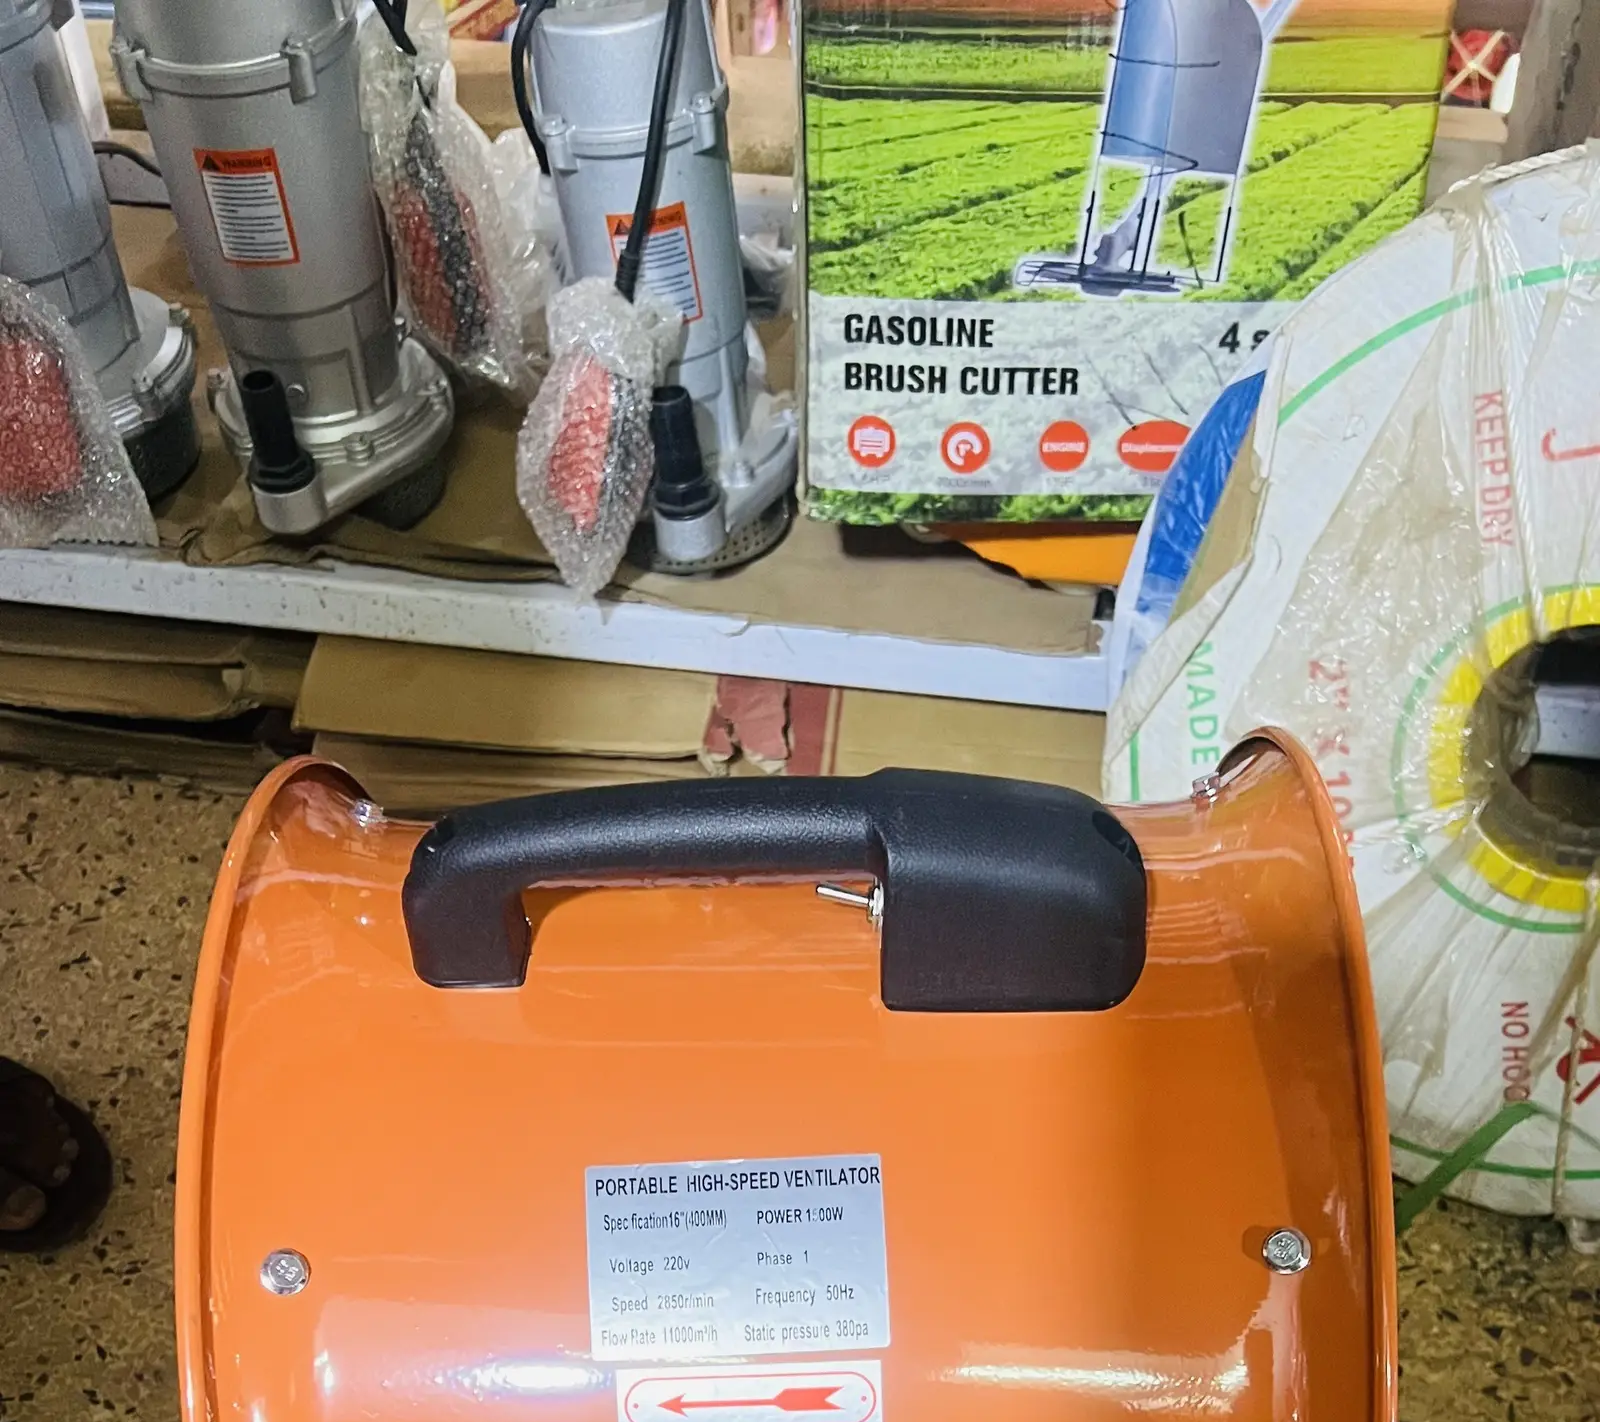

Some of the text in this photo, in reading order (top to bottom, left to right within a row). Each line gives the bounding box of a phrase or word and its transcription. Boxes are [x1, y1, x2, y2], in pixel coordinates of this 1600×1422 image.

[844, 313, 995, 348] GASOLINE
[1219, 322, 1240, 353] 4
[844, 362, 1080, 396] BRUSH CUTTER
[1473, 389, 1515, 546] KEEP DRY
[1186, 641, 1221, 765] MADE
[1501, 1002, 1530, 1101] NO HOO
[595, 1166, 880, 1196] PORTABLE HIGH-SPEED VENTILATOR
[756, 1208, 802, 1225] POWER
[609, 1255, 691, 1276] Voltage 220v
[757, 1249, 809, 1266] Phase 1
[611, 1292, 714, 1315] Speed 2850r/min
[755, 1283, 855, 1308] Frequency 50Hz
[601, 1329, 628, 1346] Flow
[631, 1328, 656, 1345] Rate
[744, 1319, 869, 1344] Static pressure 380pa
